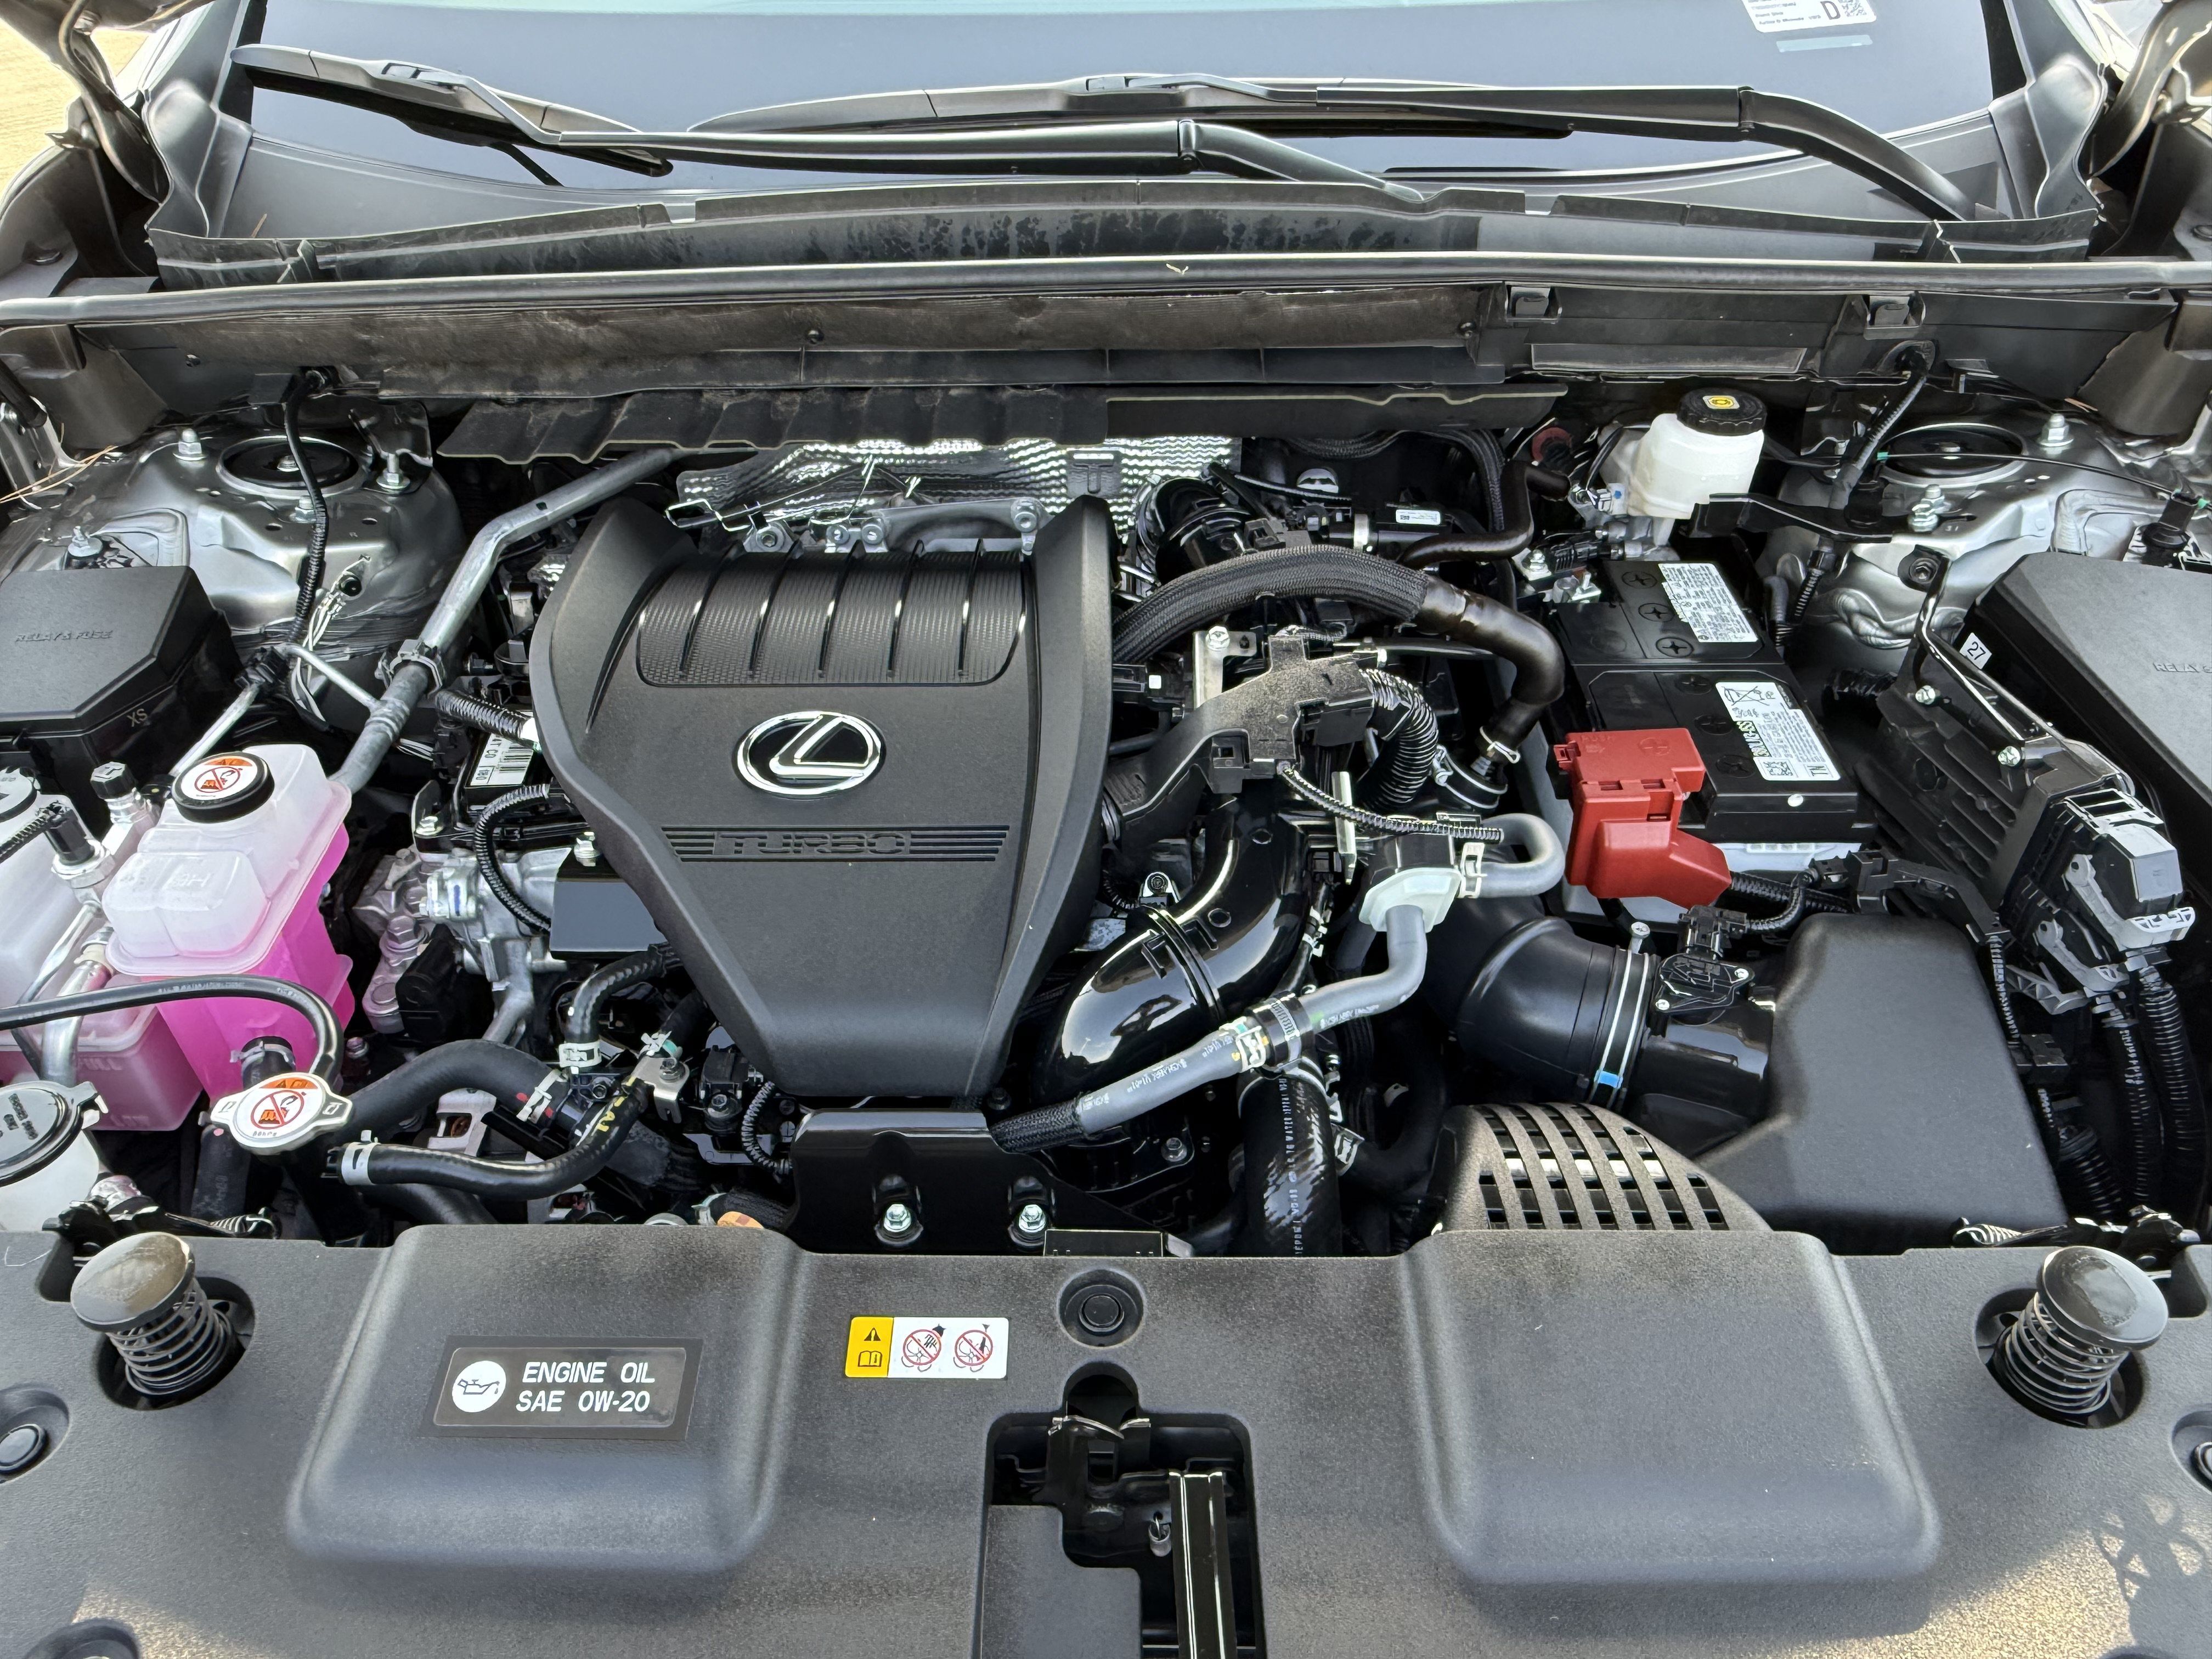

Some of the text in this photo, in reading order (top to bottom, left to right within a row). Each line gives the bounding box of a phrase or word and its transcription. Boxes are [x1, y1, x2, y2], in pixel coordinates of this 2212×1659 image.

[1820, 1, 1841, 20] D
[1966, 641, 1986, 660] 27
[127, 708, 148, 727] XS
[719, 832, 906, 855] TURBO
[522, 1362, 656, 1383] ENGINE OIL
[516, 1390, 651, 1412] SAE 0W-20
